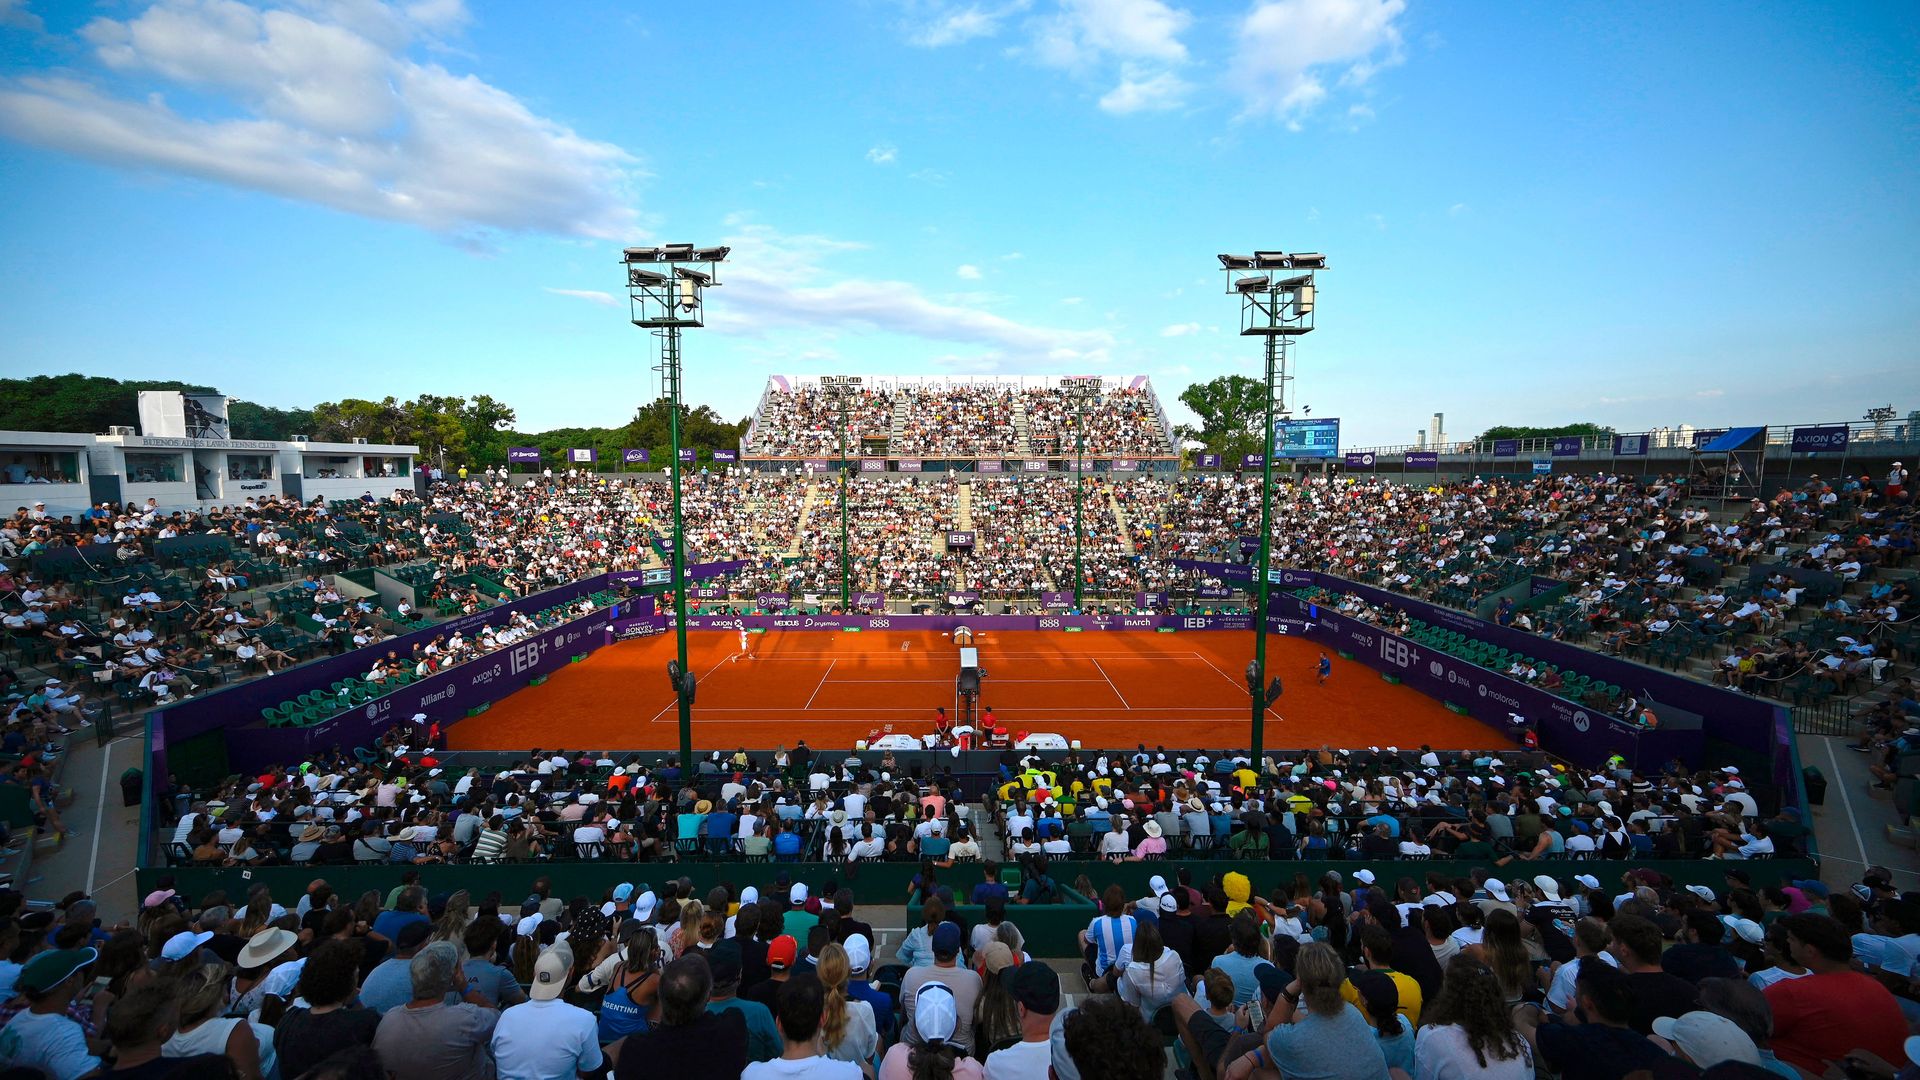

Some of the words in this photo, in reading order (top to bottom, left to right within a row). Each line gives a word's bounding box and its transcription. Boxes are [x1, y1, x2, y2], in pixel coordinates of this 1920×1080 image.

[879, 380, 892, 389] Tu
[928, 380, 942, 389] de
[143, 438, 179, 447] BUENOS
[207, 440, 229, 448] LAWN
[1795, 434, 1829, 444] AXION
[1025, 462, 1046, 470] IEB+
[949, 534, 972, 543] IEB+
[698, 589, 718, 597] IEB+
[814, 620, 840, 628] prysmian
[1184, 617, 1213, 628] IEB+
[1351, 631, 1367, 643] AXION
[510, 638, 548, 676] IEB+
[1380, 636, 1420, 669] IEB+
[472, 668, 493, 685] AXION
[1457, 677, 1471, 689] BNA
[420, 691, 446, 708] Allianz
[1488, 690, 1520, 708] motorola
[378, 700, 391, 713] LG
[1551, 702, 1573, 716] Andina
